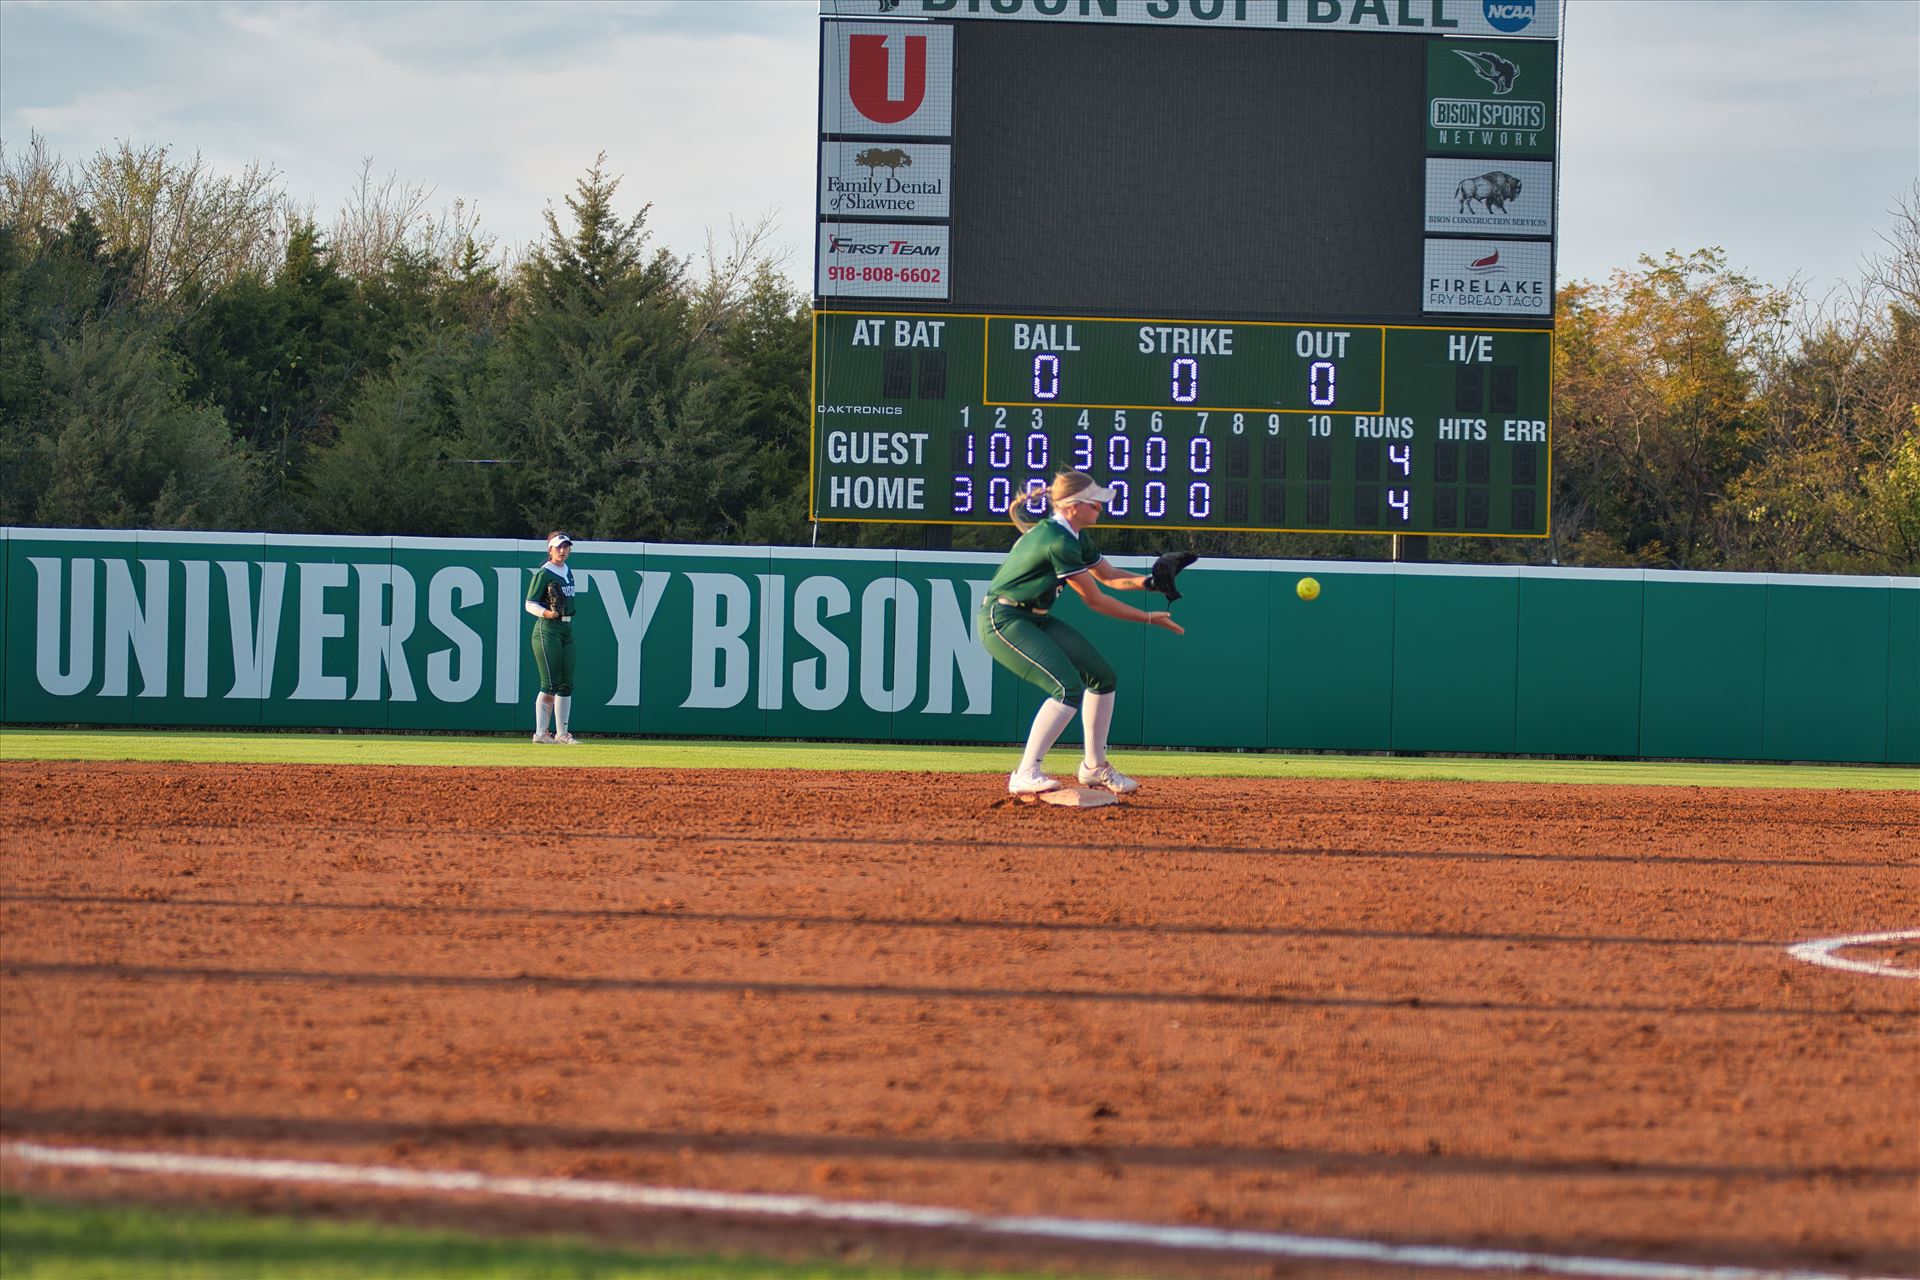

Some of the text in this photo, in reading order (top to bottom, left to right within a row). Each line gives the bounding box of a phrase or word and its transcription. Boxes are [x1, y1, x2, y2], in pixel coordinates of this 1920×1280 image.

[1488, 4, 1535, 19] NCAA
[1437, 103, 1541, 126] BISON SPORTS
[1440, 130, 1537, 146] NETWORK
[827, 176, 942, 196] Family Dental
[830, 193, 915, 210] of Shawnee
[1428, 215, 1548, 227] BISON CONSTRUCTION SERVICES
[828, 266, 941, 283] 918-808-6602
[1430, 279, 1543, 294] FIRELAKE
[1430, 293, 1543, 307] FRY BREAD TACO
[852, 320, 945, 348] AT BAT
[1014, 323, 1080, 351] BALL
[1139, 326, 1233, 356] STRIKE
[1296, 330, 1350, 358] OUT
[1449, 335, 1493, 363] H/E
[1033, 354, 1059, 399] 0
[1172, 358, 1198, 402] 0
[1310, 362, 1335, 406] 0
[817, 404, 903, 415] DAKTRONICS
[960, 407, 1546, 442] 1 2 3 4 5 6 7 8 9 10 RUNS HITS ERR
[828, 431, 929, 465] GUEST
[967, 433, 1410, 475] 1 0 0 3 0 0 0 4
[830, 475, 925, 510] HOME
[954, 476, 973, 513] 3
[989, 477, 1010, 513] 0
[1108, 481, 1128, 515] 0
[1145, 482, 1166, 517] 0
[1189, 482, 1210, 518] 0
[1388, 489, 1409, 520] 4
[679, 572, 993, 716] BISON
